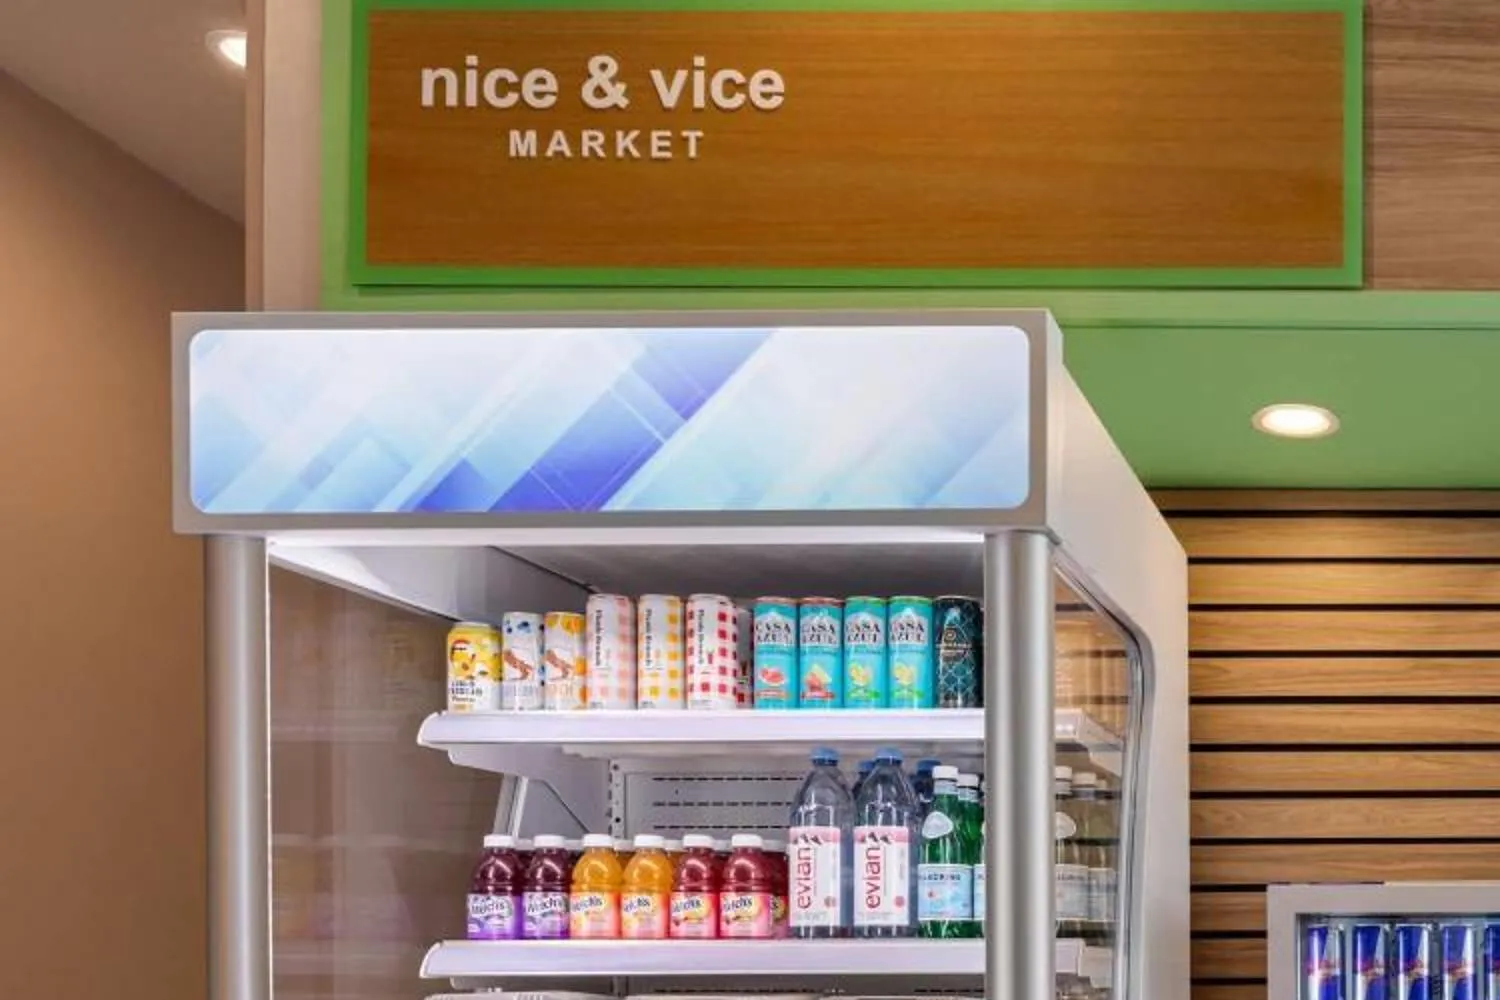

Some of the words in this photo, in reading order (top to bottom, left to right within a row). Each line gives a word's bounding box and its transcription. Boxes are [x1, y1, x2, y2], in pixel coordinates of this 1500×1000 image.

[421, 55, 559, 109] nice
[580, 54, 629, 109] &
[649, 56, 785, 109] vice
[508, 130, 704, 159] MARKET
[755, 622, 791, 632] CASA
[802, 622, 836, 633] CASA
[846, 621, 880, 632] CASA
[890, 622, 925, 632] CASA
[796, 847, 811, 909] evian
[864, 846, 880, 909] evian
